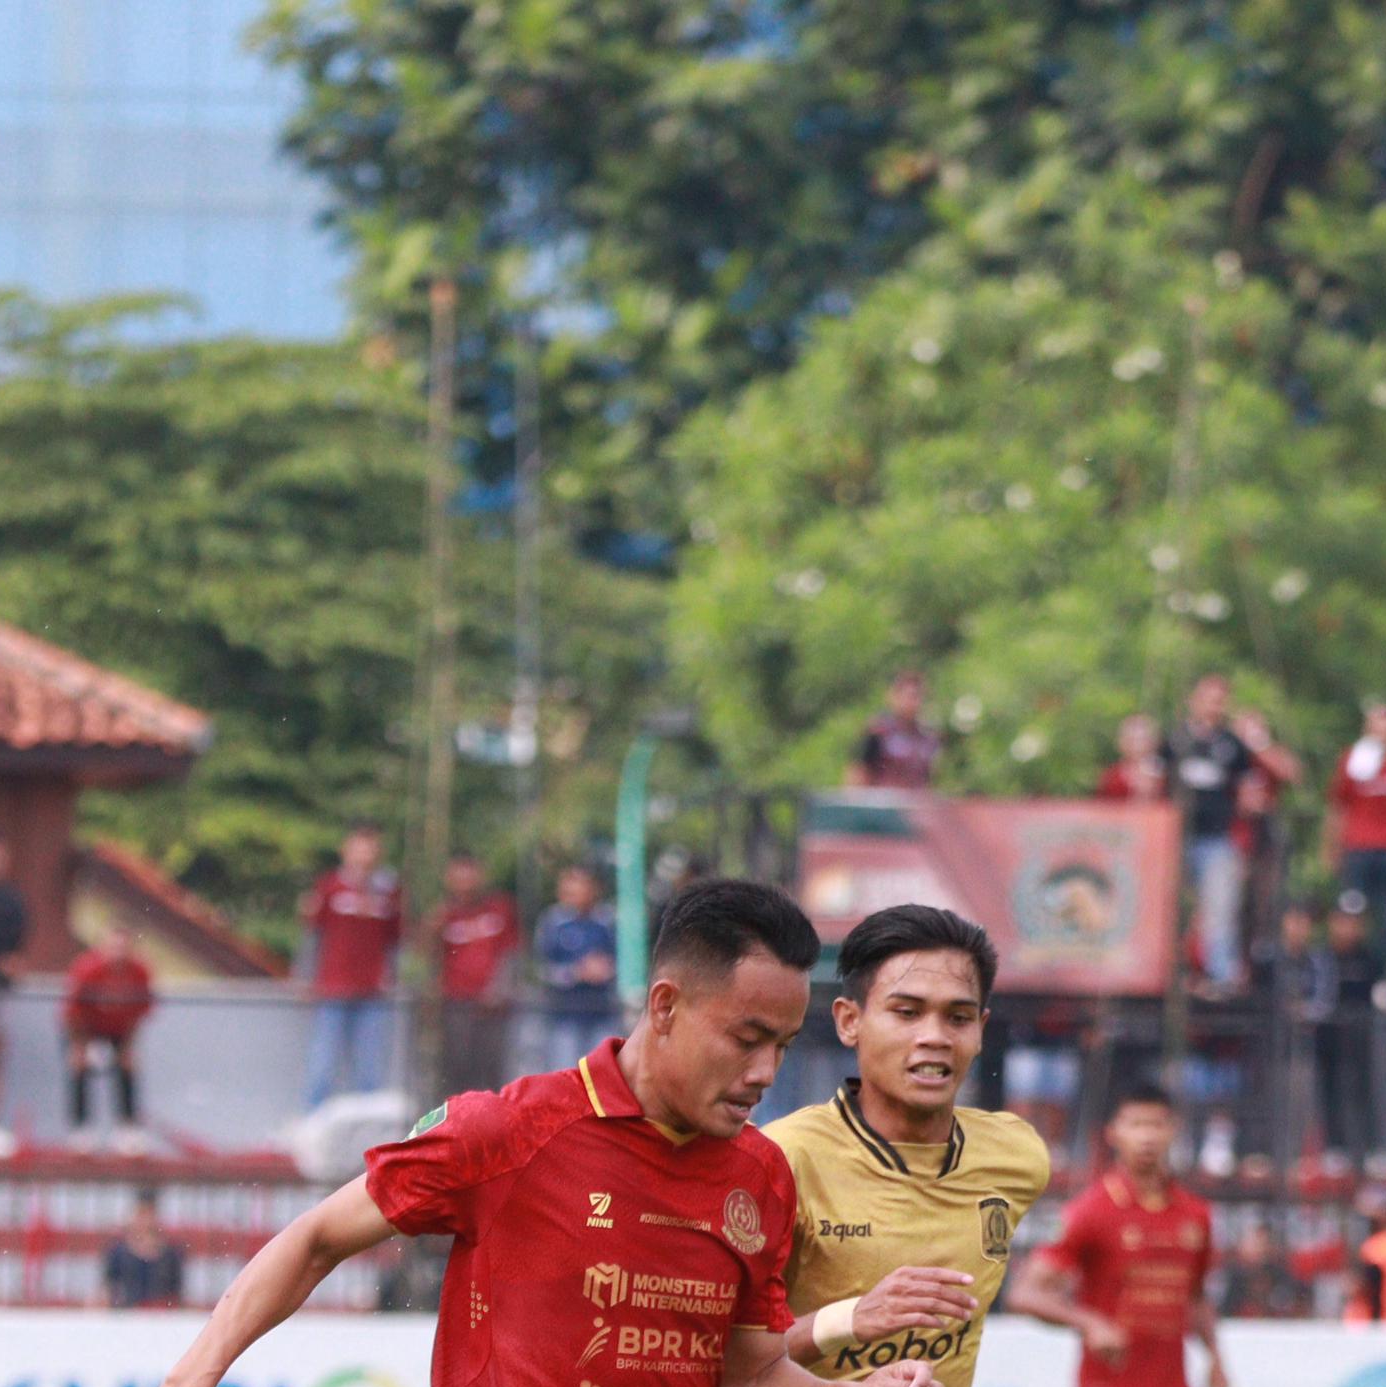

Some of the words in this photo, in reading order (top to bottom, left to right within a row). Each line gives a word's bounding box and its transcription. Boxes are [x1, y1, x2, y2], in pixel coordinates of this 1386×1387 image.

[586, 1217, 613, 1229] NINE
[633, 1273, 716, 1298] MONSTER
[719, 1282, 738, 1299] LA
[631, 1292, 733, 1316] INTERNASION
[617, 1326, 683, 1359] BPR
[690, 1331, 725, 1360] KC
[616, 1357, 640, 1371] BPR
